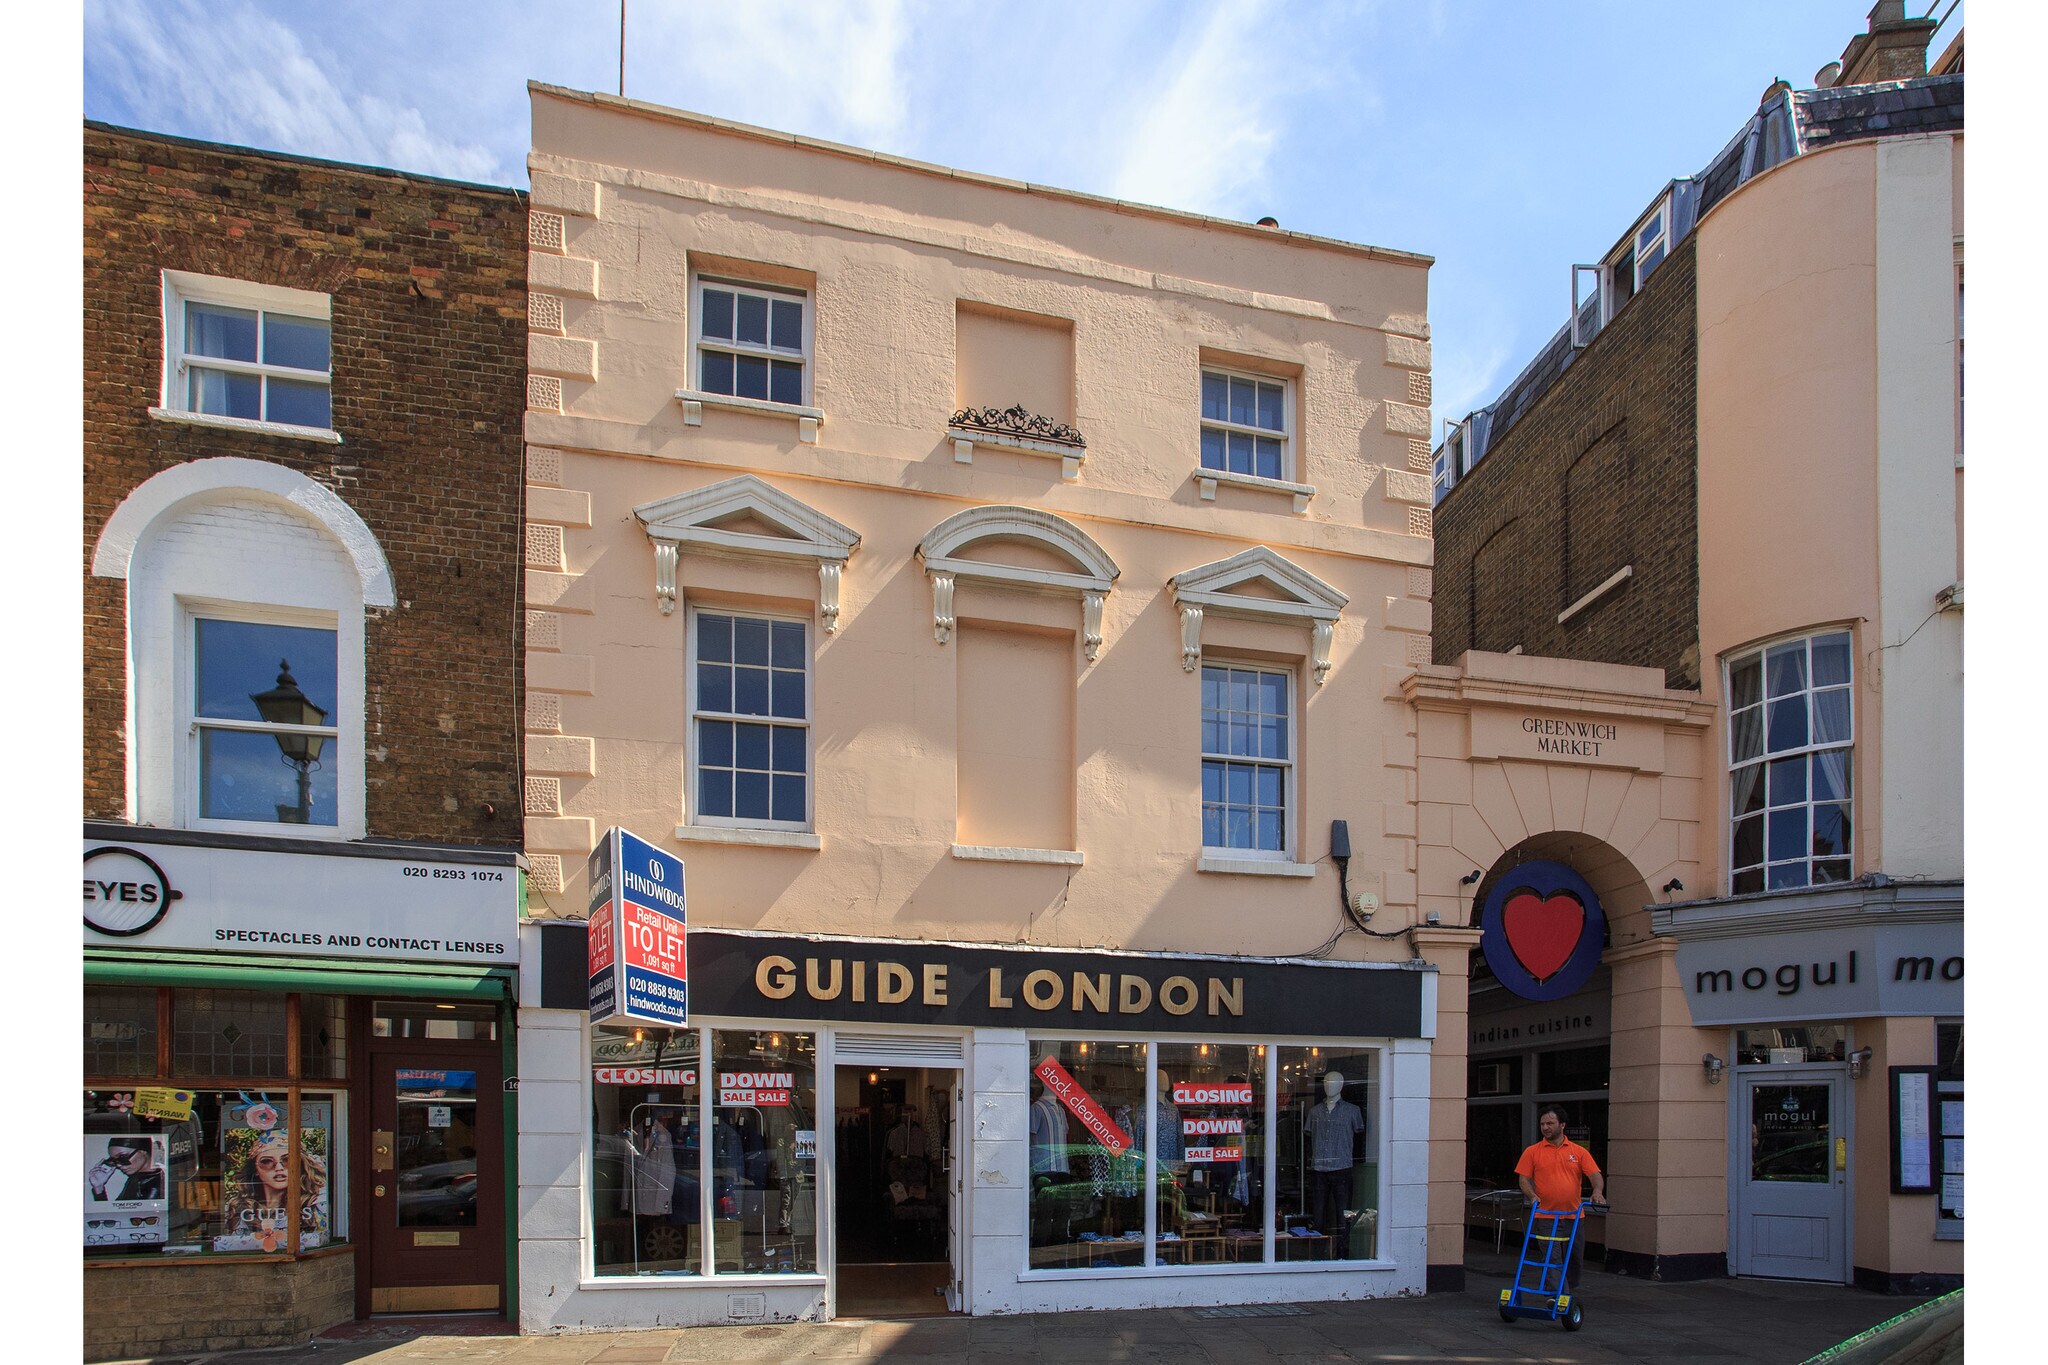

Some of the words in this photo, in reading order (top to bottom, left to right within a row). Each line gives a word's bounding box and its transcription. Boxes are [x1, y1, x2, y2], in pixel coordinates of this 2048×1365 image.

[1522, 717, 1617, 741] GREENWICH
[1537, 737, 1603, 757] MARKET
[403, 866, 428, 878] 020
[433, 868, 466, 880] 8293
[471, 871, 503, 882] 1074
[84, 880, 158, 903] EYES
[625, 869, 685, 912] HINDWOODS
[636, 907, 661, 929] Retail
[662, 917, 678, 936] Unit
[215, 929, 322, 946] SPECTACLES
[327, 935, 361, 948] AND
[366, 937, 440, 951] CONTACT
[445, 941, 504, 955] LENSES
[598, 920, 611, 953] LET
[628, 920, 654, 952] TO
[658, 931, 684, 962] LET
[642, 953, 660, 968] 1,091
[661, 962, 670, 974] sq
[670, 962, 676, 973] ft
[1696, 950, 1856, 996] mogul
[629, 976, 646, 993] 020
[647, 981, 667, 998] 8858
[667, 986, 685, 1002] 9303
[755, 955, 949, 1006] GUIDE
[989, 967, 1244, 1017] LONDON
[629, 994, 685, 1018] hindwoods.co.uk
[1473, 1027, 1519, 1044] indian
[1529, 1014, 1592, 1036] cuisine
[595, 1067, 696, 1085] CLOSING
[721, 1073, 793, 1088] DOWN
[724, 1092, 752, 1102] SALE
[758, 1092, 787, 1102] SALE
[1173, 1089, 1252, 1103] CLOSING
[1041, 1066, 1072, 1097] stock
[1069, 1097, 1121, 1150] clearance
[1764, 1110, 1816, 1123] mogul
[1183, 1120, 1242, 1133] DOWN
[1187, 1150, 1211, 1159] SALE
[1215, 1149, 1239, 1158] SALE
[240, 1206, 314, 1222] GUES
